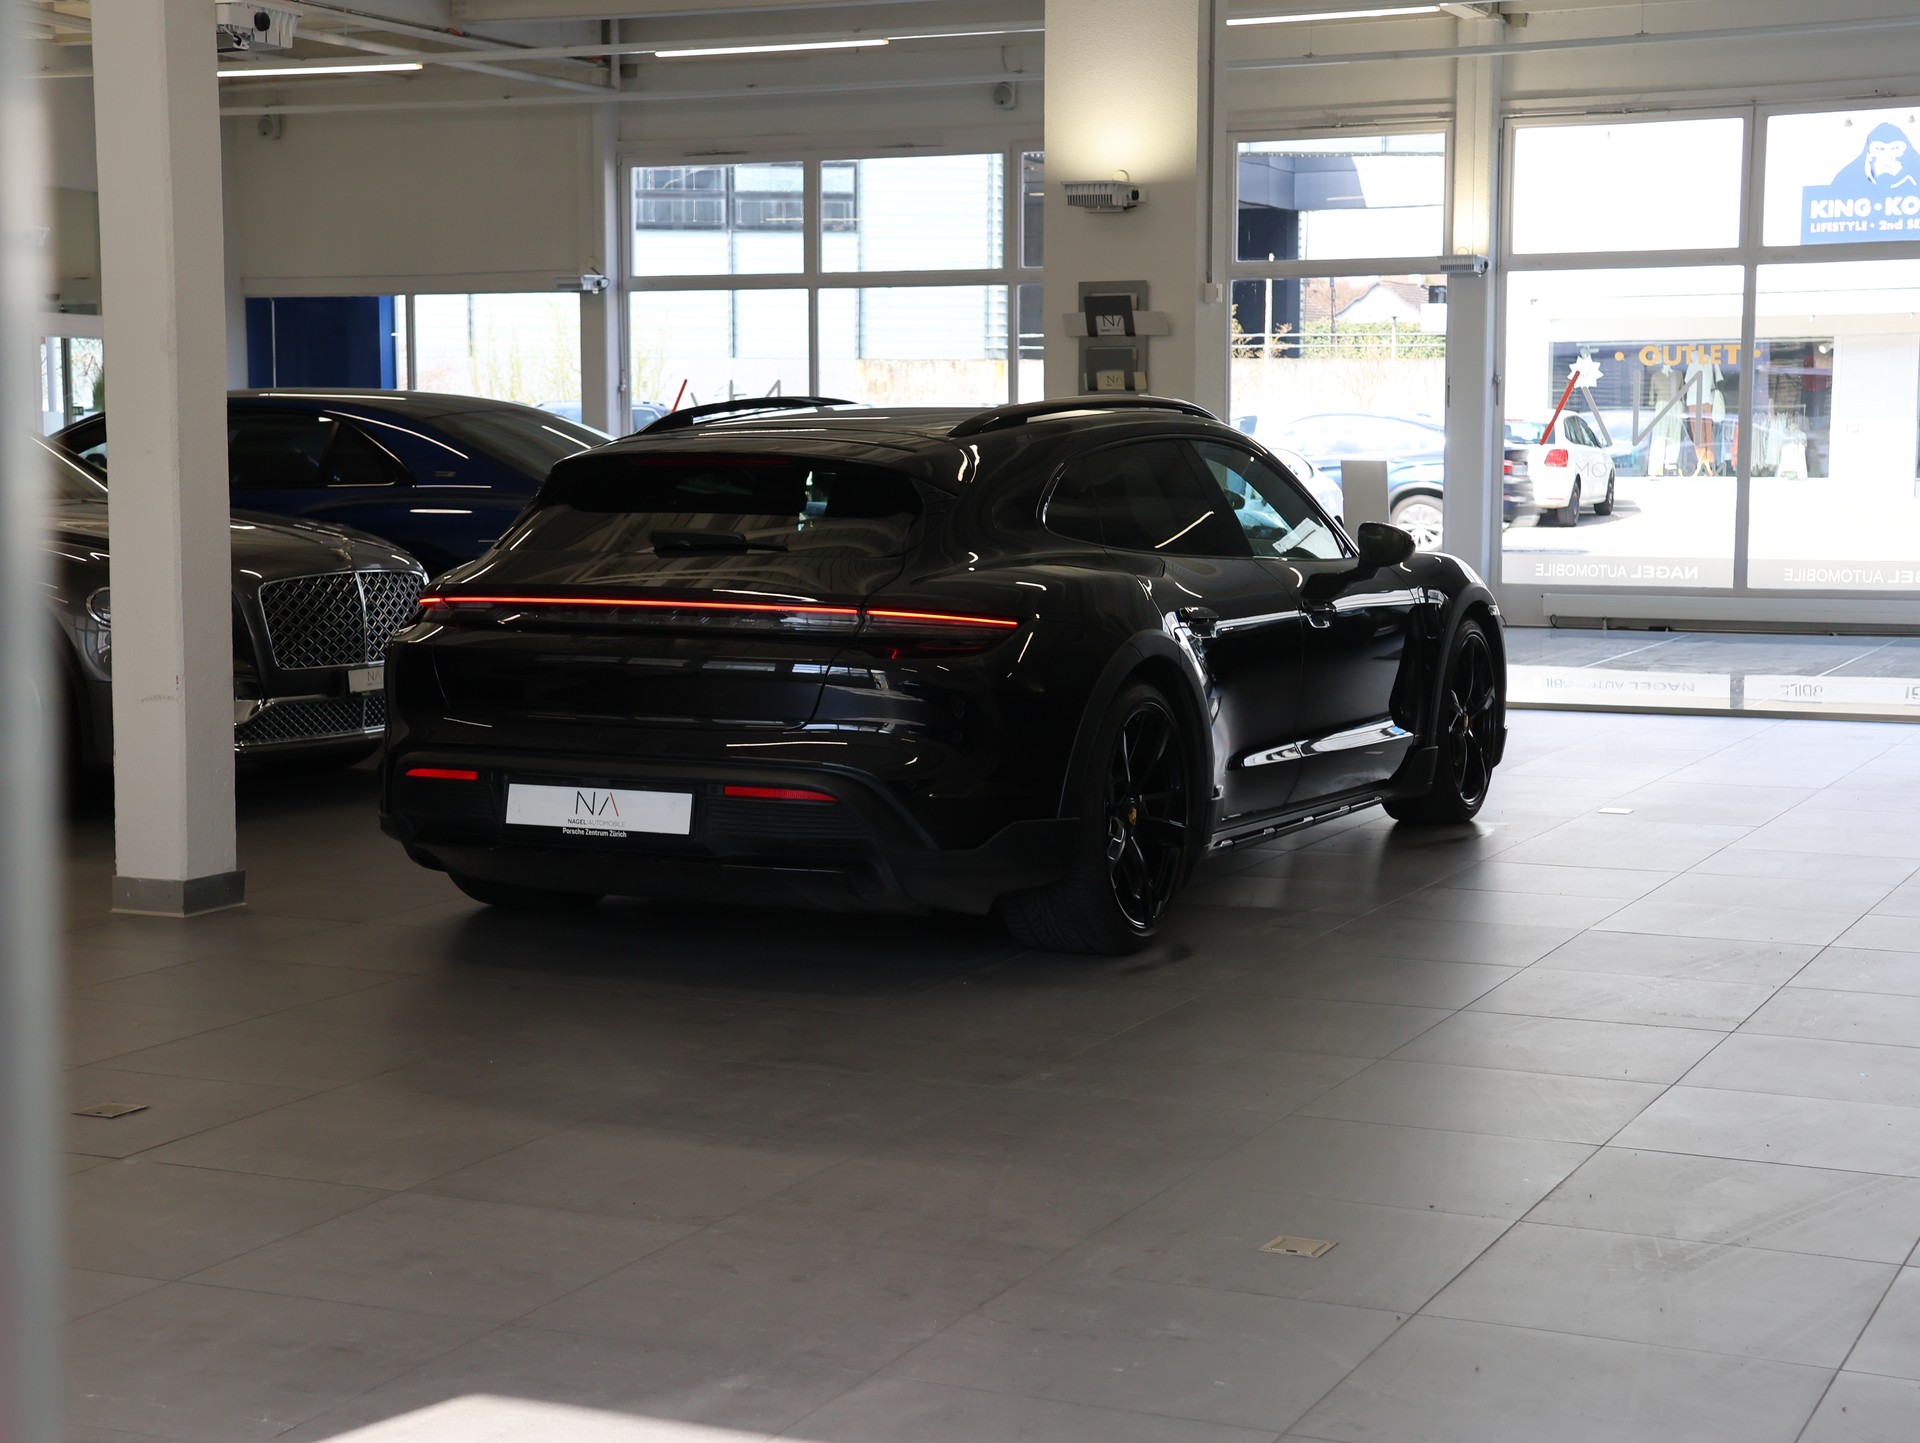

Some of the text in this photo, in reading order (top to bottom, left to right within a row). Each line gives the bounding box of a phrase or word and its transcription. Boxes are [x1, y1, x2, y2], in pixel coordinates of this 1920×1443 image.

[1811, 198, 1871, 219] KING
[1810, 220, 1868, 233] LIFESTYLE
[1879, 218, 1904, 231] 2nd
[1638, 344, 1742, 367] OUTLET
[567, 818, 626, 828] NAGEL AUTOMOBILE
[562, 827, 627, 838] Porsche Zentrum Zürich
